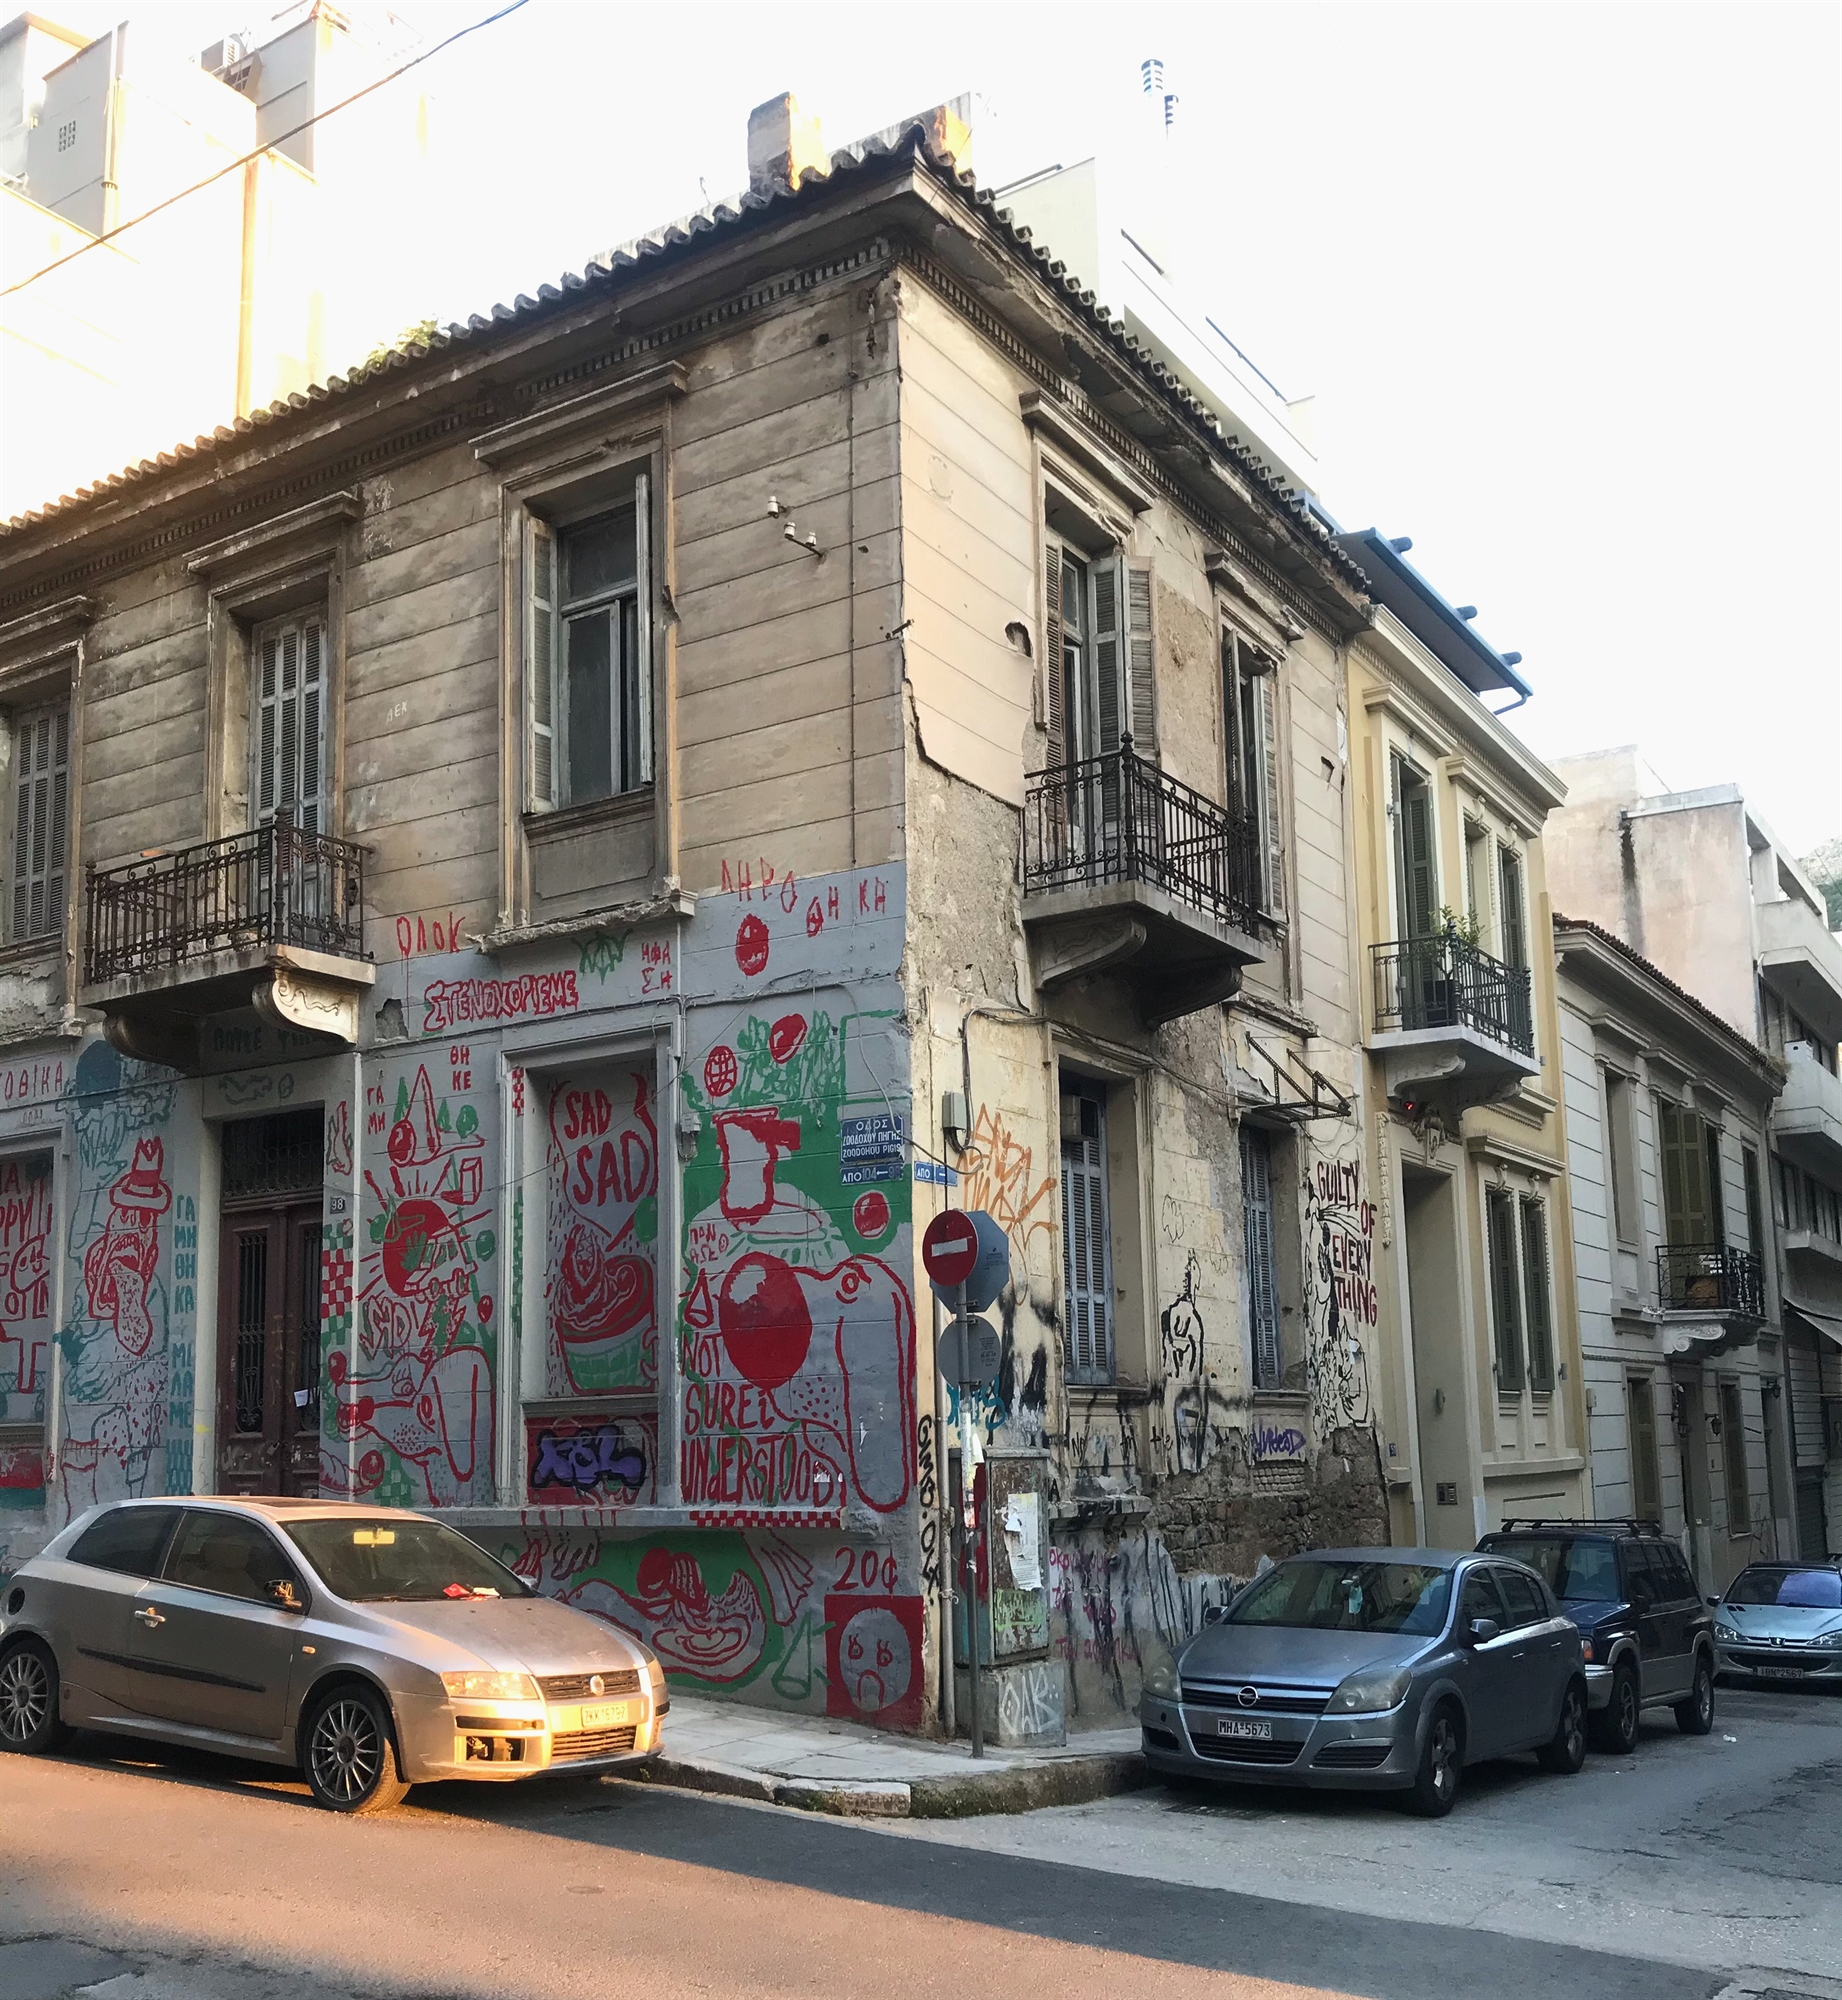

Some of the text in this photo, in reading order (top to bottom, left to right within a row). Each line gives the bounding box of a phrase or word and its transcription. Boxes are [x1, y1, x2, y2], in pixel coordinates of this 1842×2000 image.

[563, 1089, 612, 1140] SAD
[855, 1118, 888, 1132] ΟΔΟΣ
[842, 1143, 902, 1159] ZOODOHOU PIGIS
[878, 1129, 902, 1143] ΠΗΓΗΣ
[572, 1130, 650, 1207] SAD
[842, 1171, 862, 1183] ΑΠΟ
[916, 1168, 931, 1179] ΑΠΟ
[1317, 1159, 1360, 1211] GUILTY
[331, 1197, 344, 1211] 98
[1360, 1198, 1378, 1235] OF
[1332, 1232, 1372, 1280] EVERY
[1334, 1273, 1378, 1328] THING
[681, 1331, 723, 1378] NOT
[684, 1382, 758, 1435] SURE
